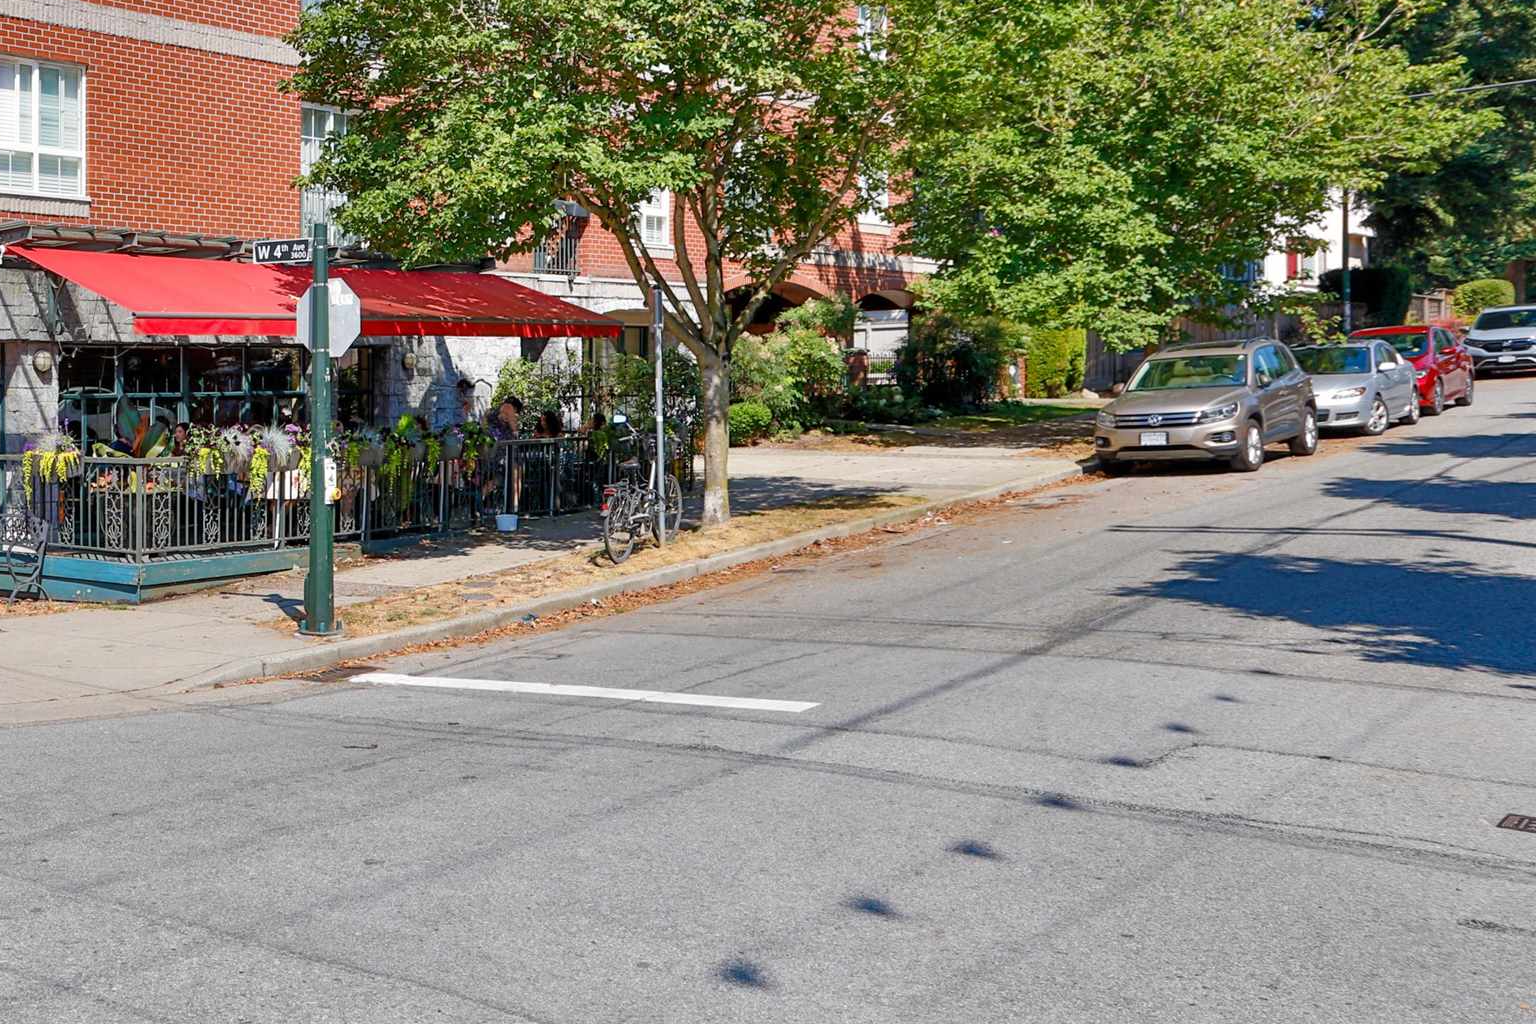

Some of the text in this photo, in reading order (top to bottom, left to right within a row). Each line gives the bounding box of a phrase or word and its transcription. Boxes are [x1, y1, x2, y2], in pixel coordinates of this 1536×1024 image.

[257, 243, 305, 259] W 4th Ave
